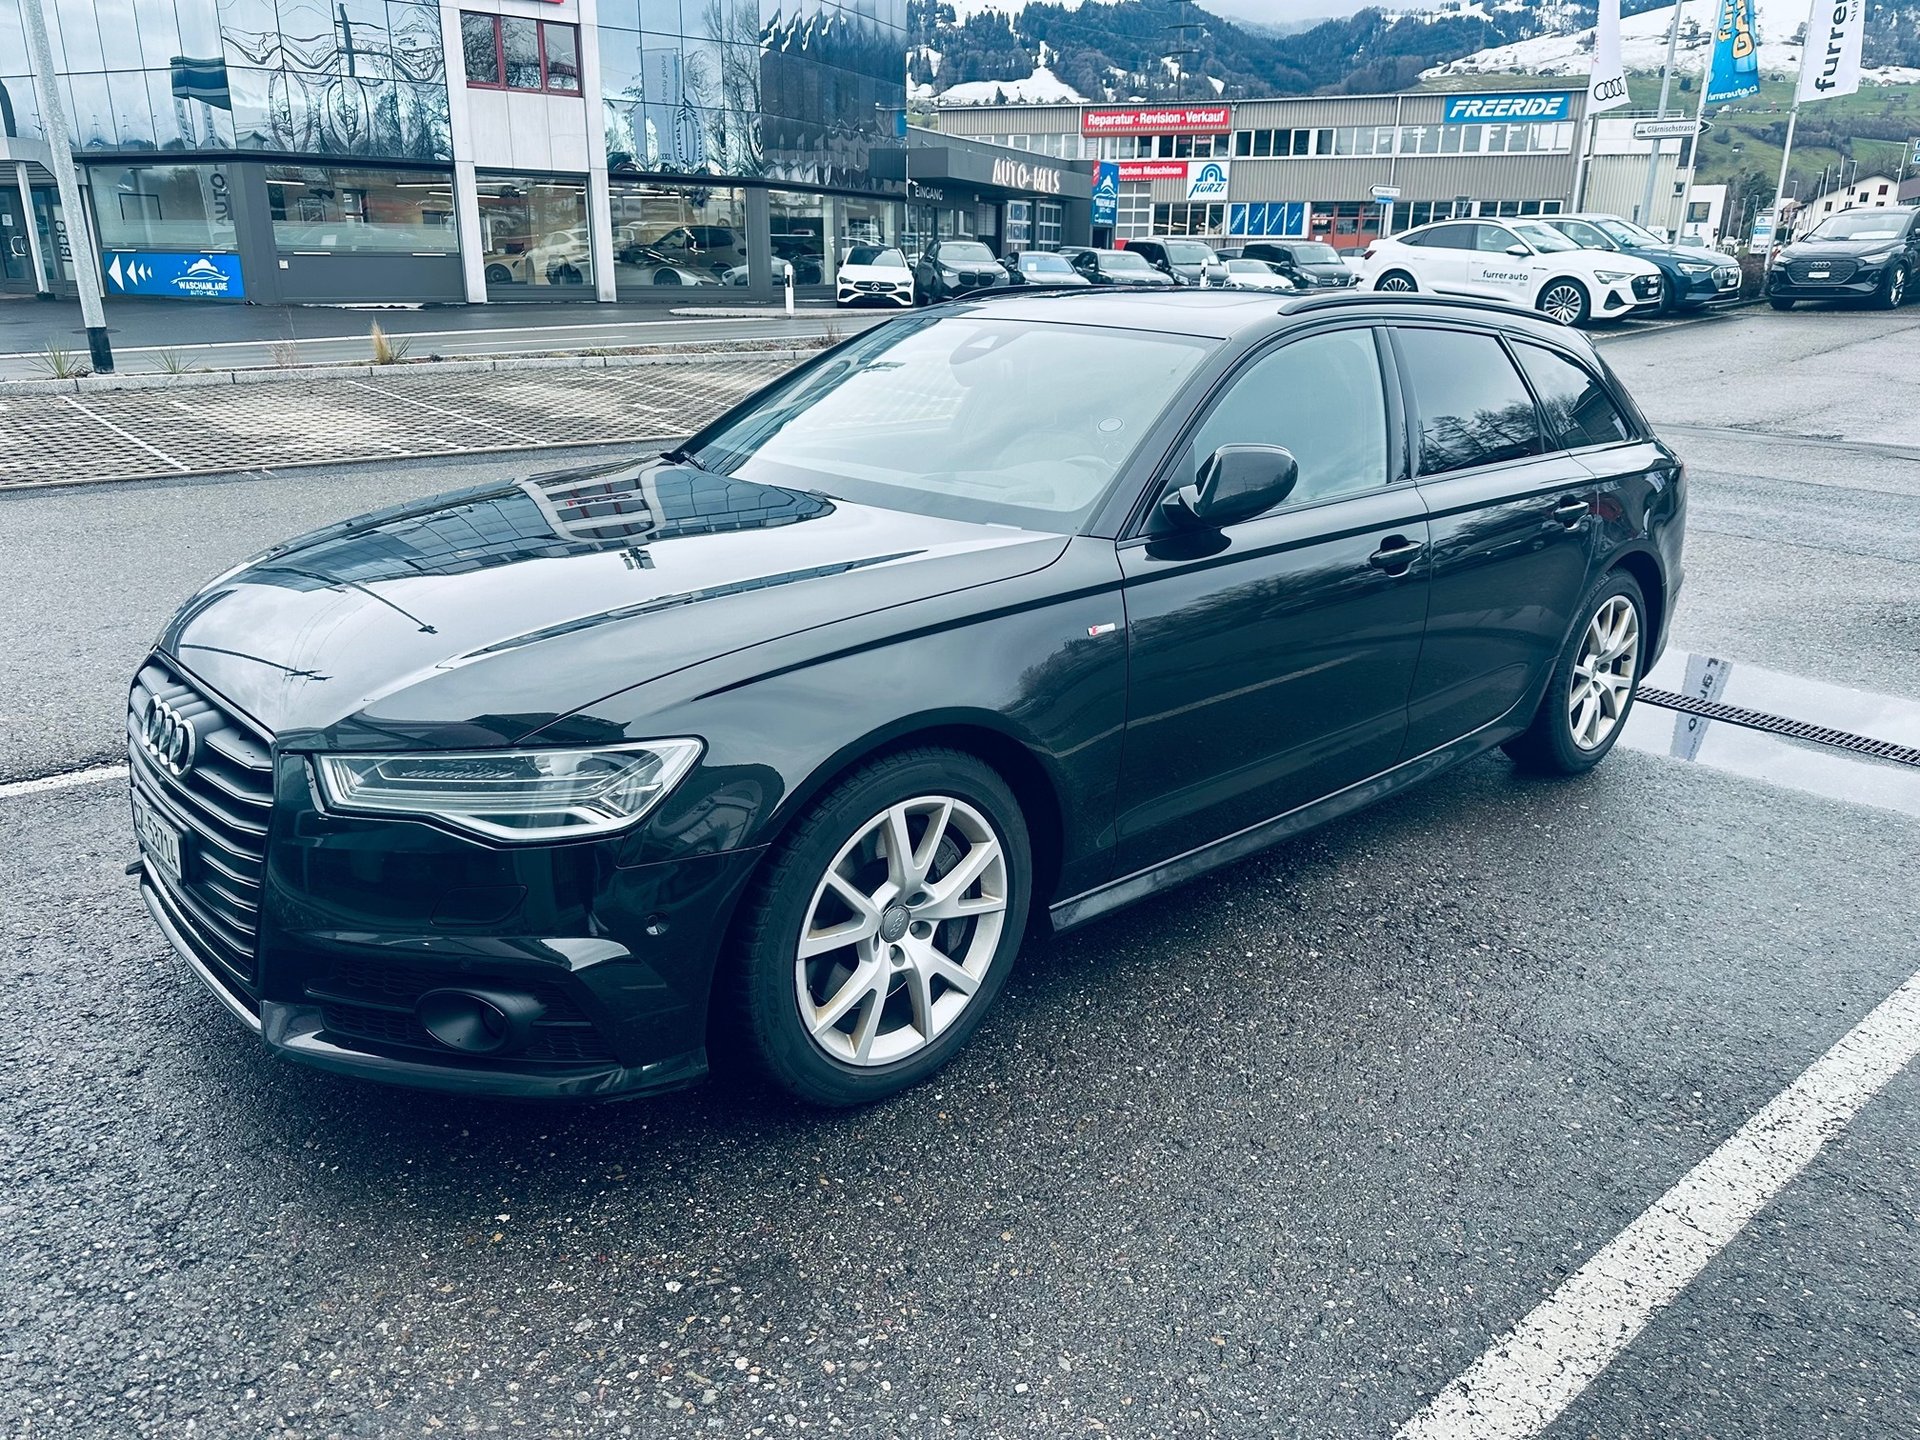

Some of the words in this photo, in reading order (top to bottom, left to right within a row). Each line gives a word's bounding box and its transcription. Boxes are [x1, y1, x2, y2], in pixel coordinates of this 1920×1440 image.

[1449, 97, 1565, 118] FREERIDE
[1087, 113, 1135, 128] Reparatur
[1139, 111, 1181, 124] Revision
[1186, 110, 1226, 123] Verkauf
[914, 185, 944, 201] EINGANG
[1482, 269, 1508, 280] furrer
[1508, 273, 1529, 281] auto
[178, 281, 229, 291] WASCHANLAGE
